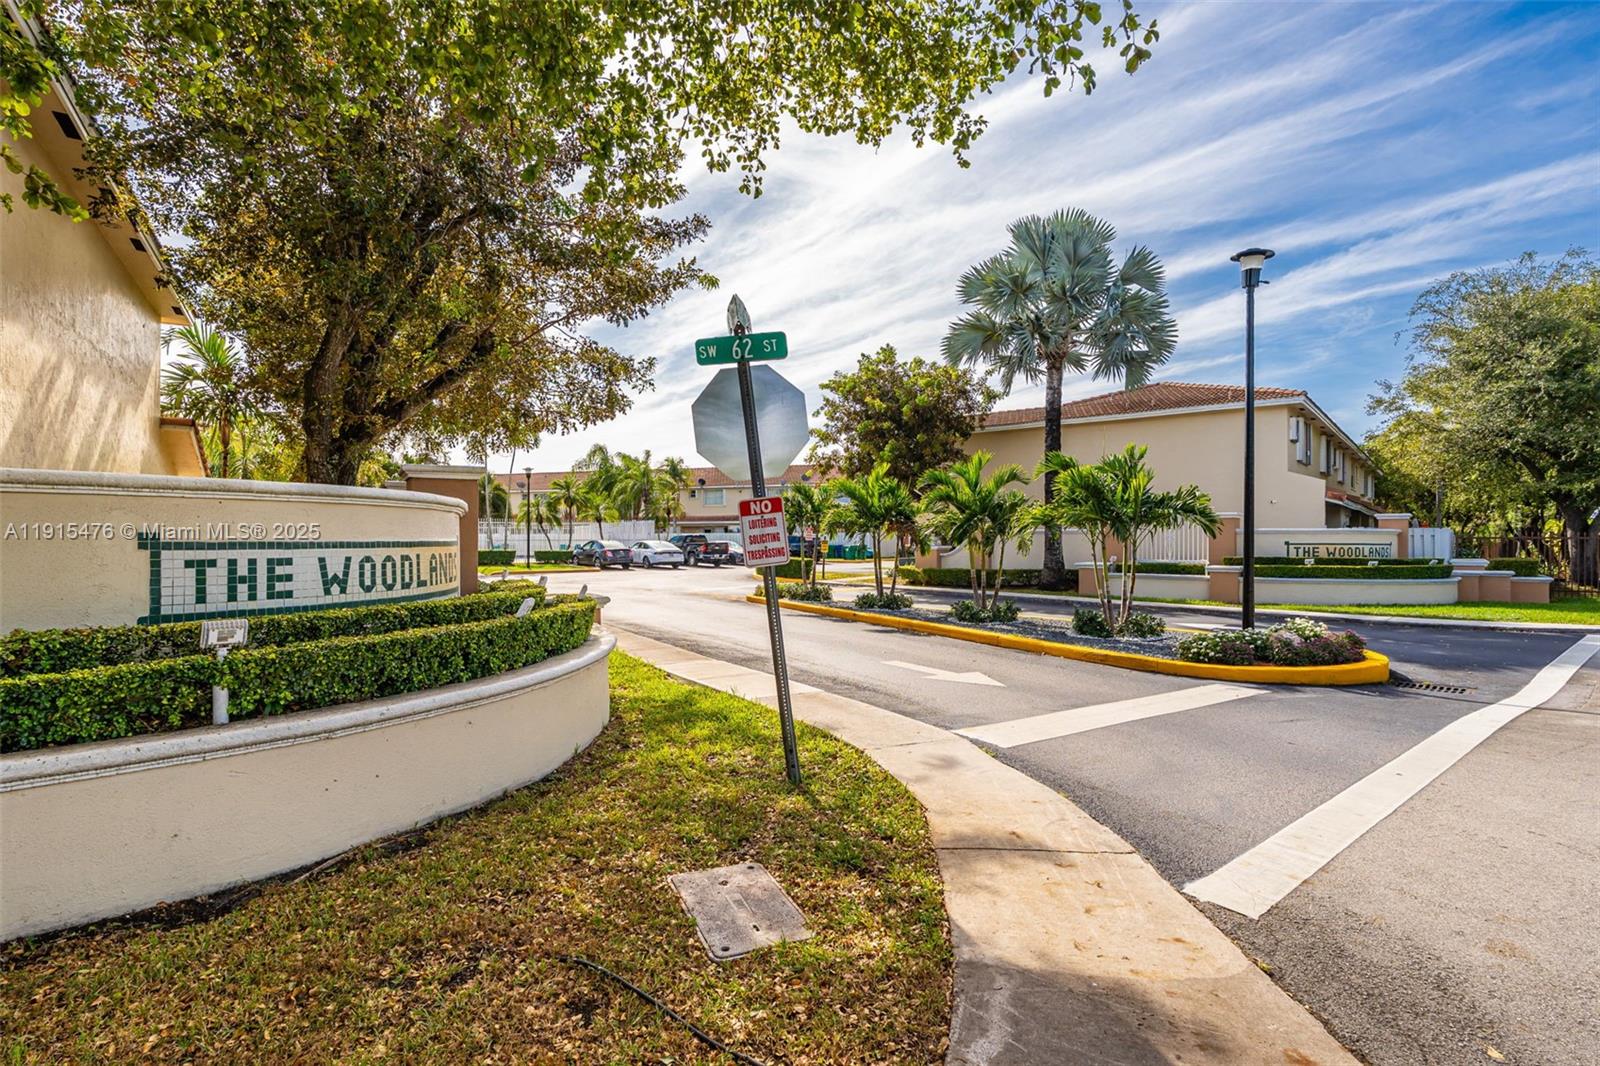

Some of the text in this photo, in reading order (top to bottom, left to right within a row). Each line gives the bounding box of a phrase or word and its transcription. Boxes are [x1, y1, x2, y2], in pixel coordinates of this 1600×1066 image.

[699, 338, 777, 359] SW 62 ST
[750, 500, 772, 514] NO
[748, 517, 777, 529] LOITERING
[749, 532, 780, 545] SOLICITING
[747, 547, 785, 560] TRESPASSING
[1294, 546, 1389, 558] THE WOODLANDS
[184, 553, 457, 604] THE WOODLANDS
